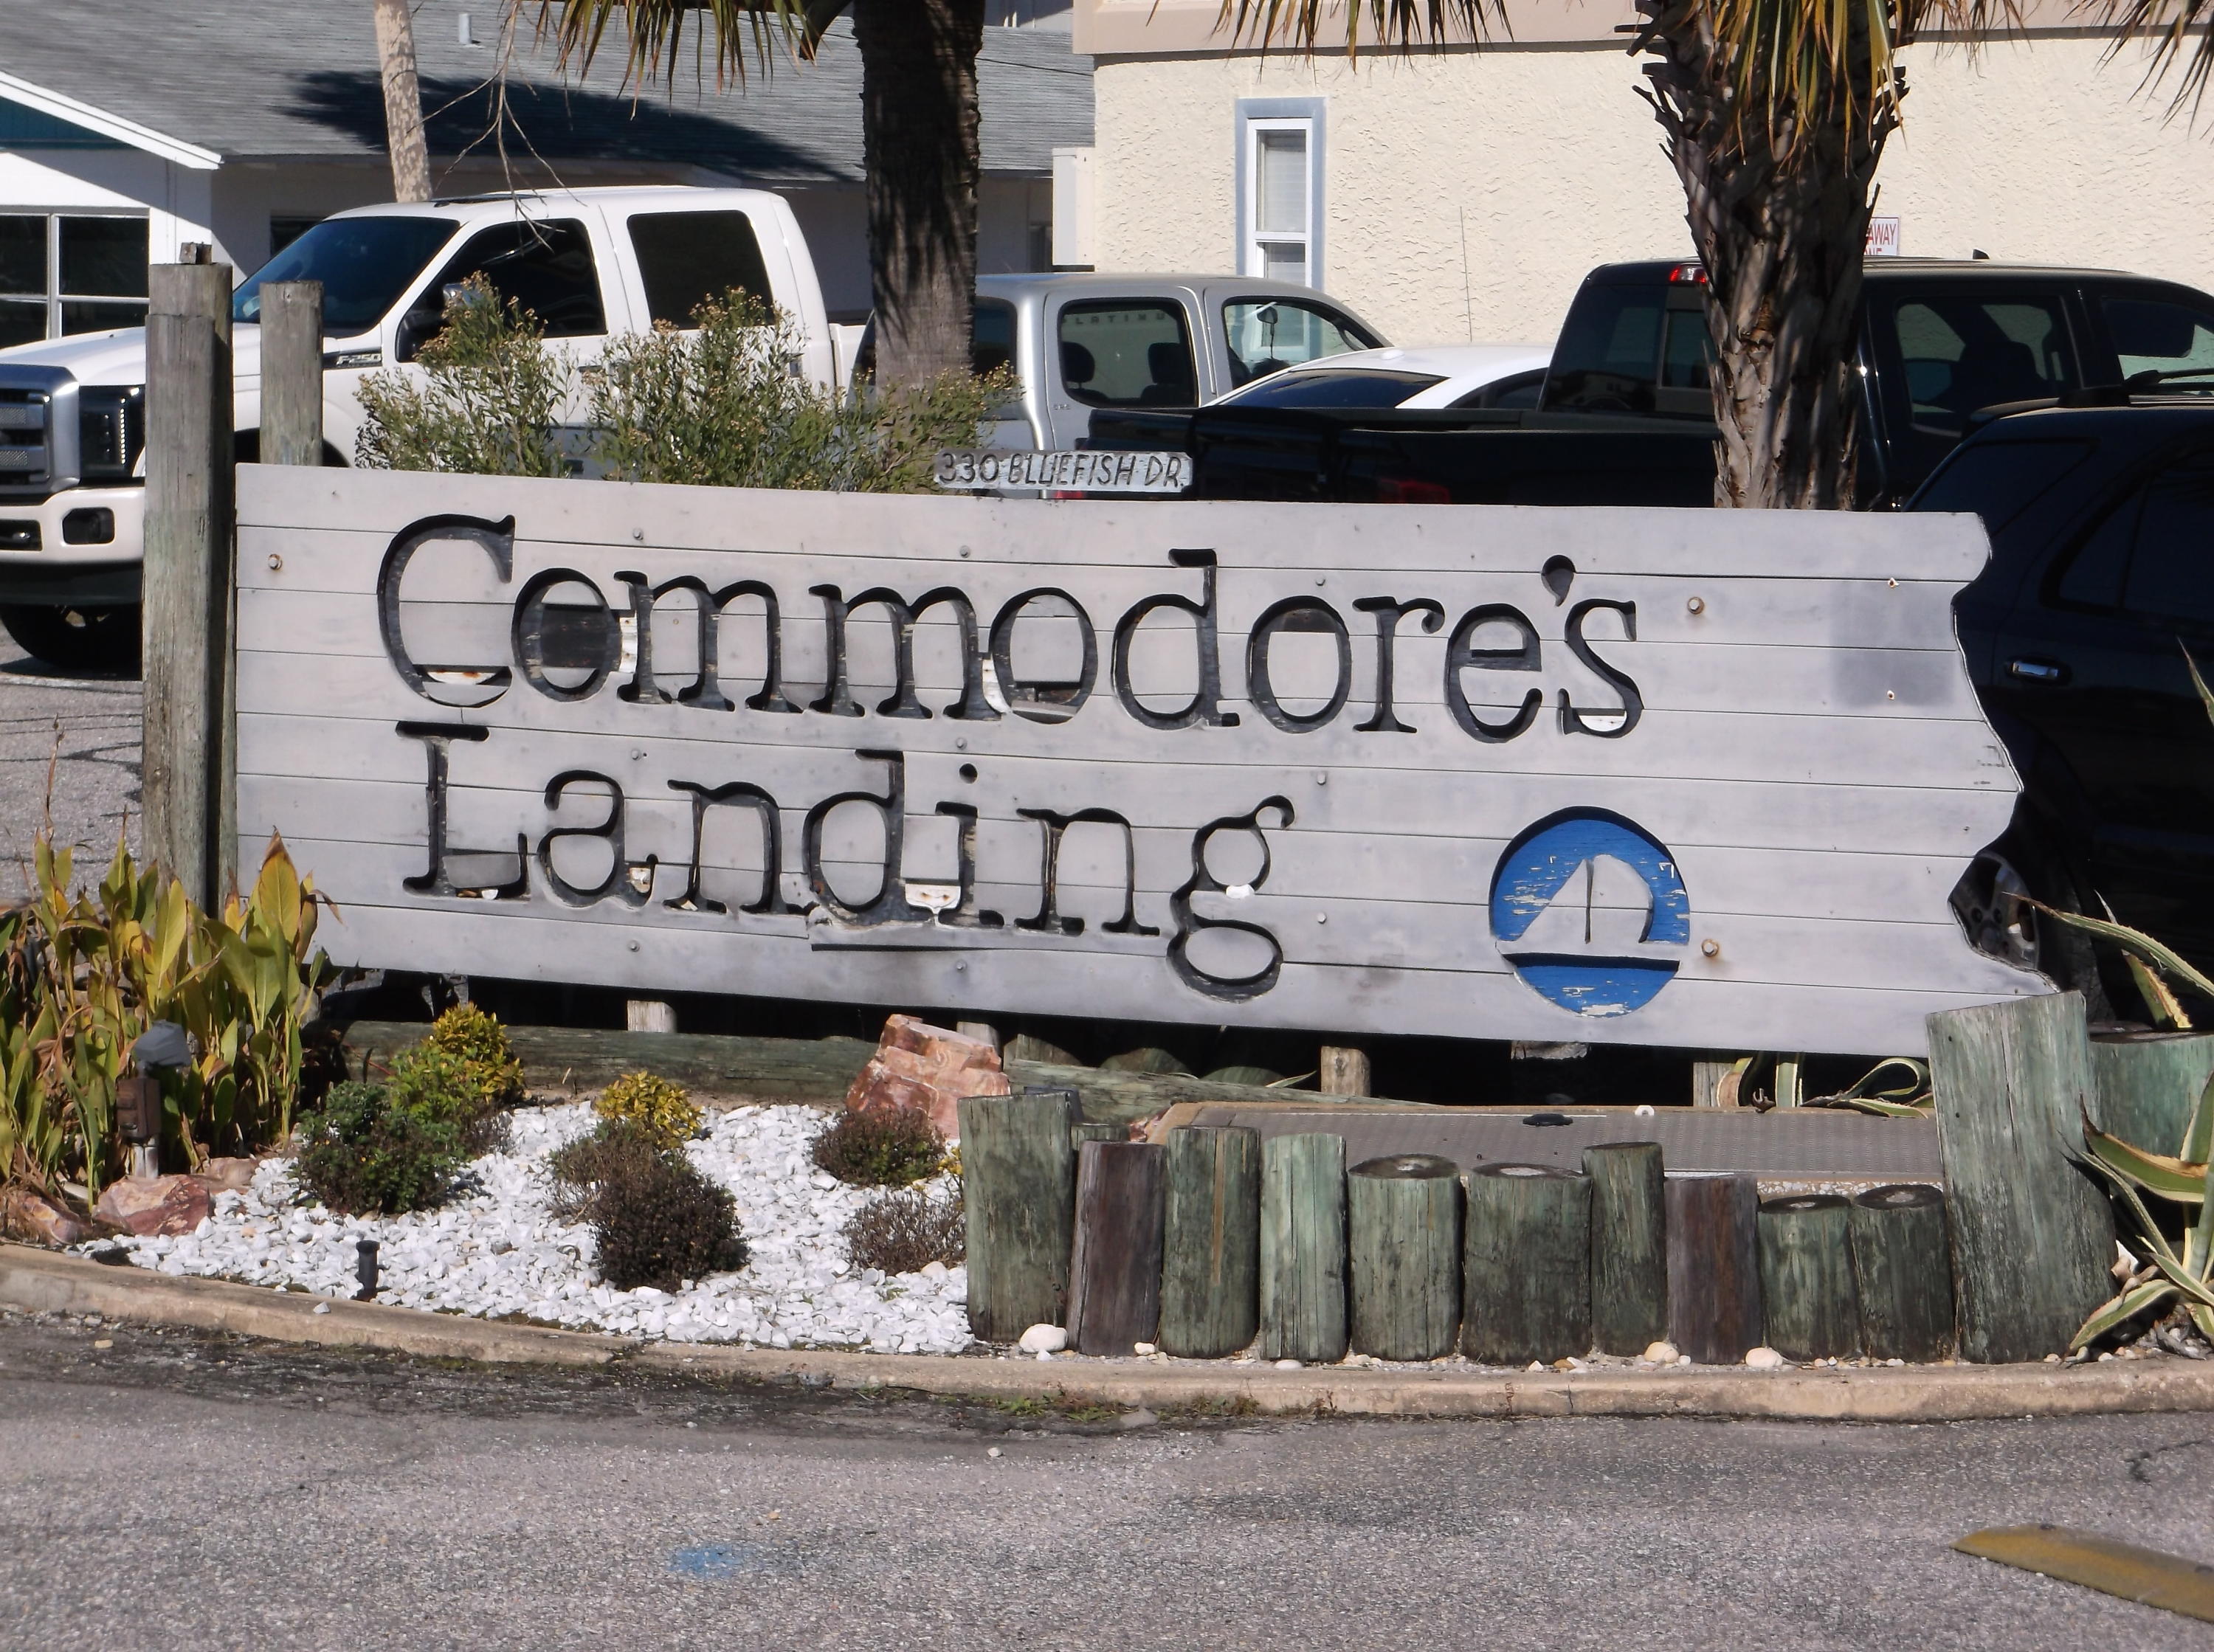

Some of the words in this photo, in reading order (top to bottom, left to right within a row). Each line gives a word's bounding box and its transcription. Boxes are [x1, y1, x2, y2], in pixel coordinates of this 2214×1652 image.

[938, 452, 999, 484] 330
[1007, 453, 1136, 486] BLUEFISH
[377, 514, 1644, 743] Commodore's
[396, 720, 1296, 1003] Landing
